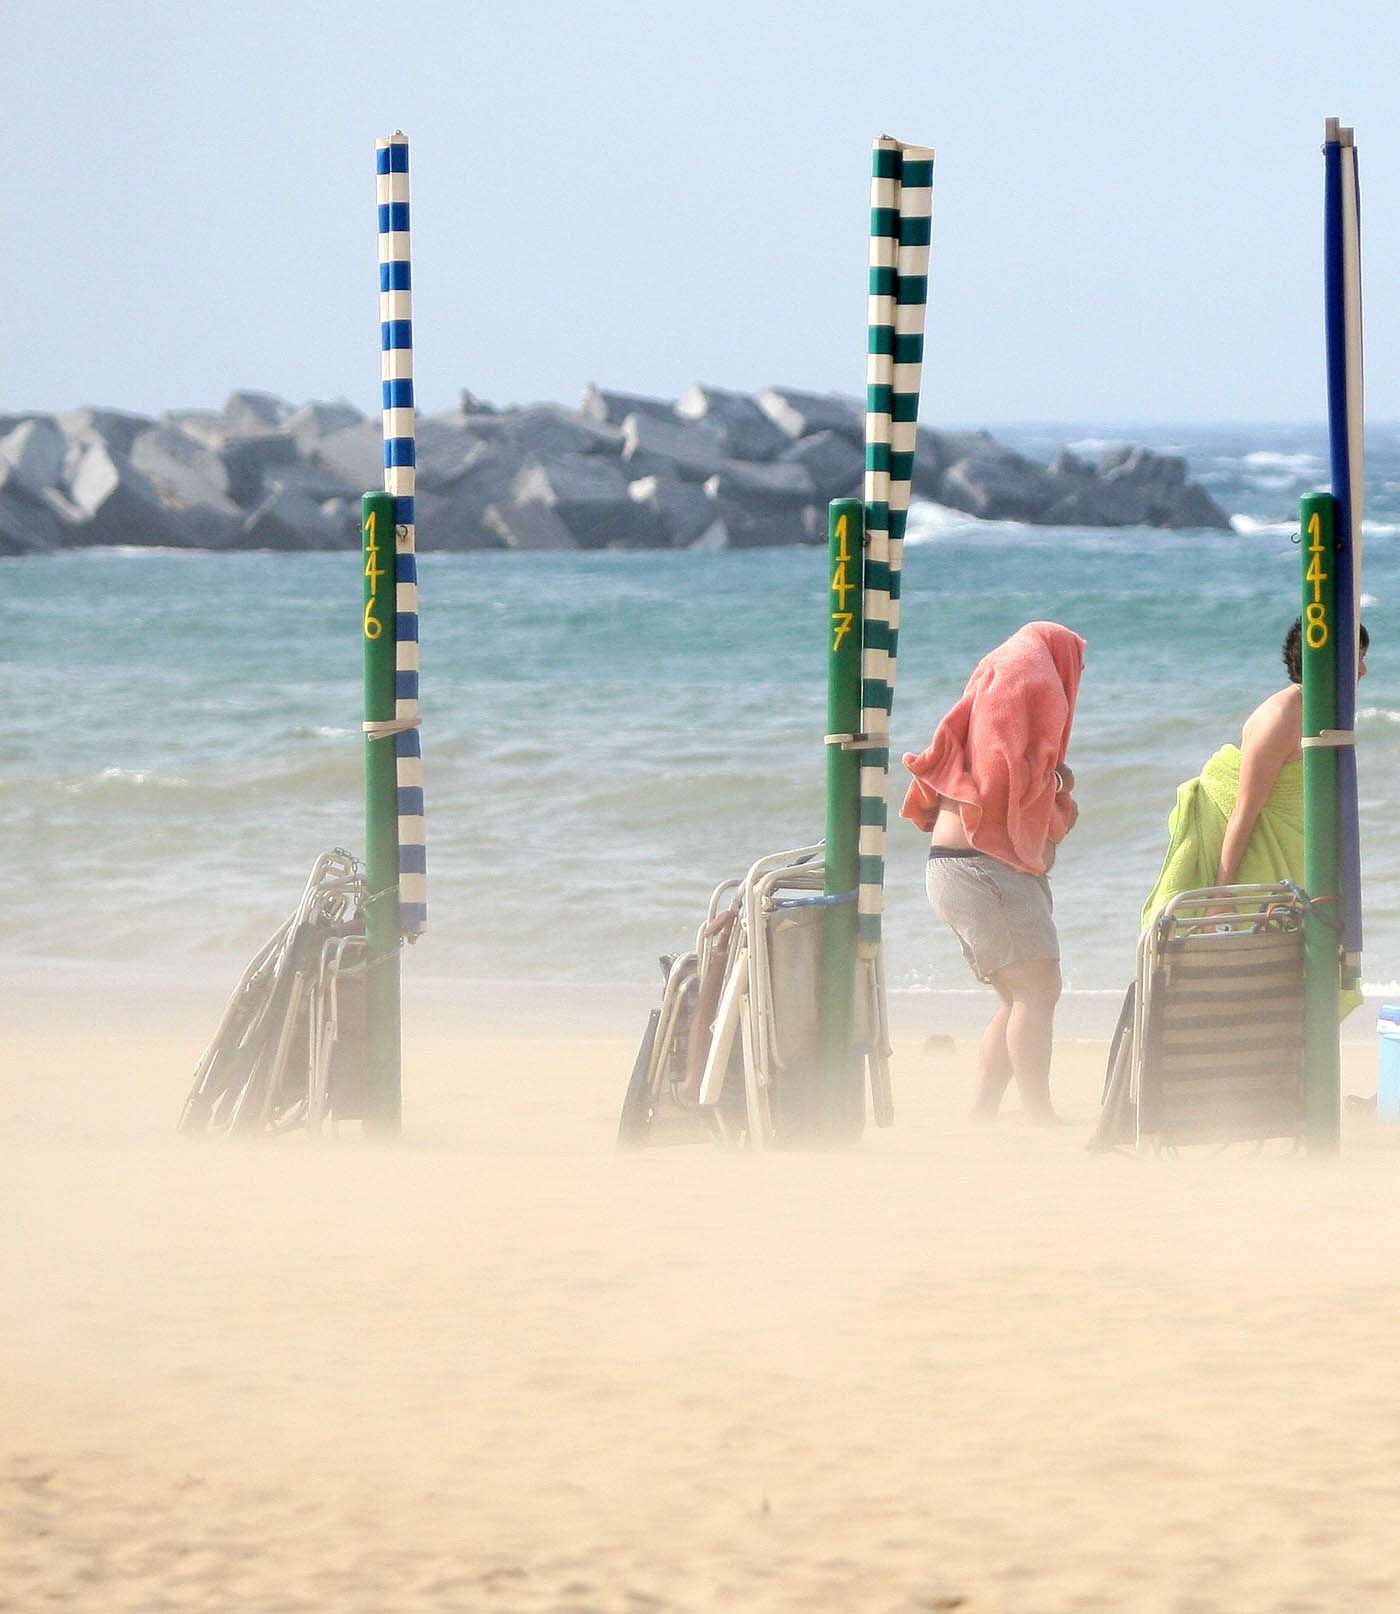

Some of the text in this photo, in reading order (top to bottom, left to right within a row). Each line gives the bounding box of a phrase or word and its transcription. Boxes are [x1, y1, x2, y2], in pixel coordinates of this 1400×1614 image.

[363, 511, 385, 640] 146
[832, 514, 855, 651] 147
[1305, 512, 1328, 649] 148
